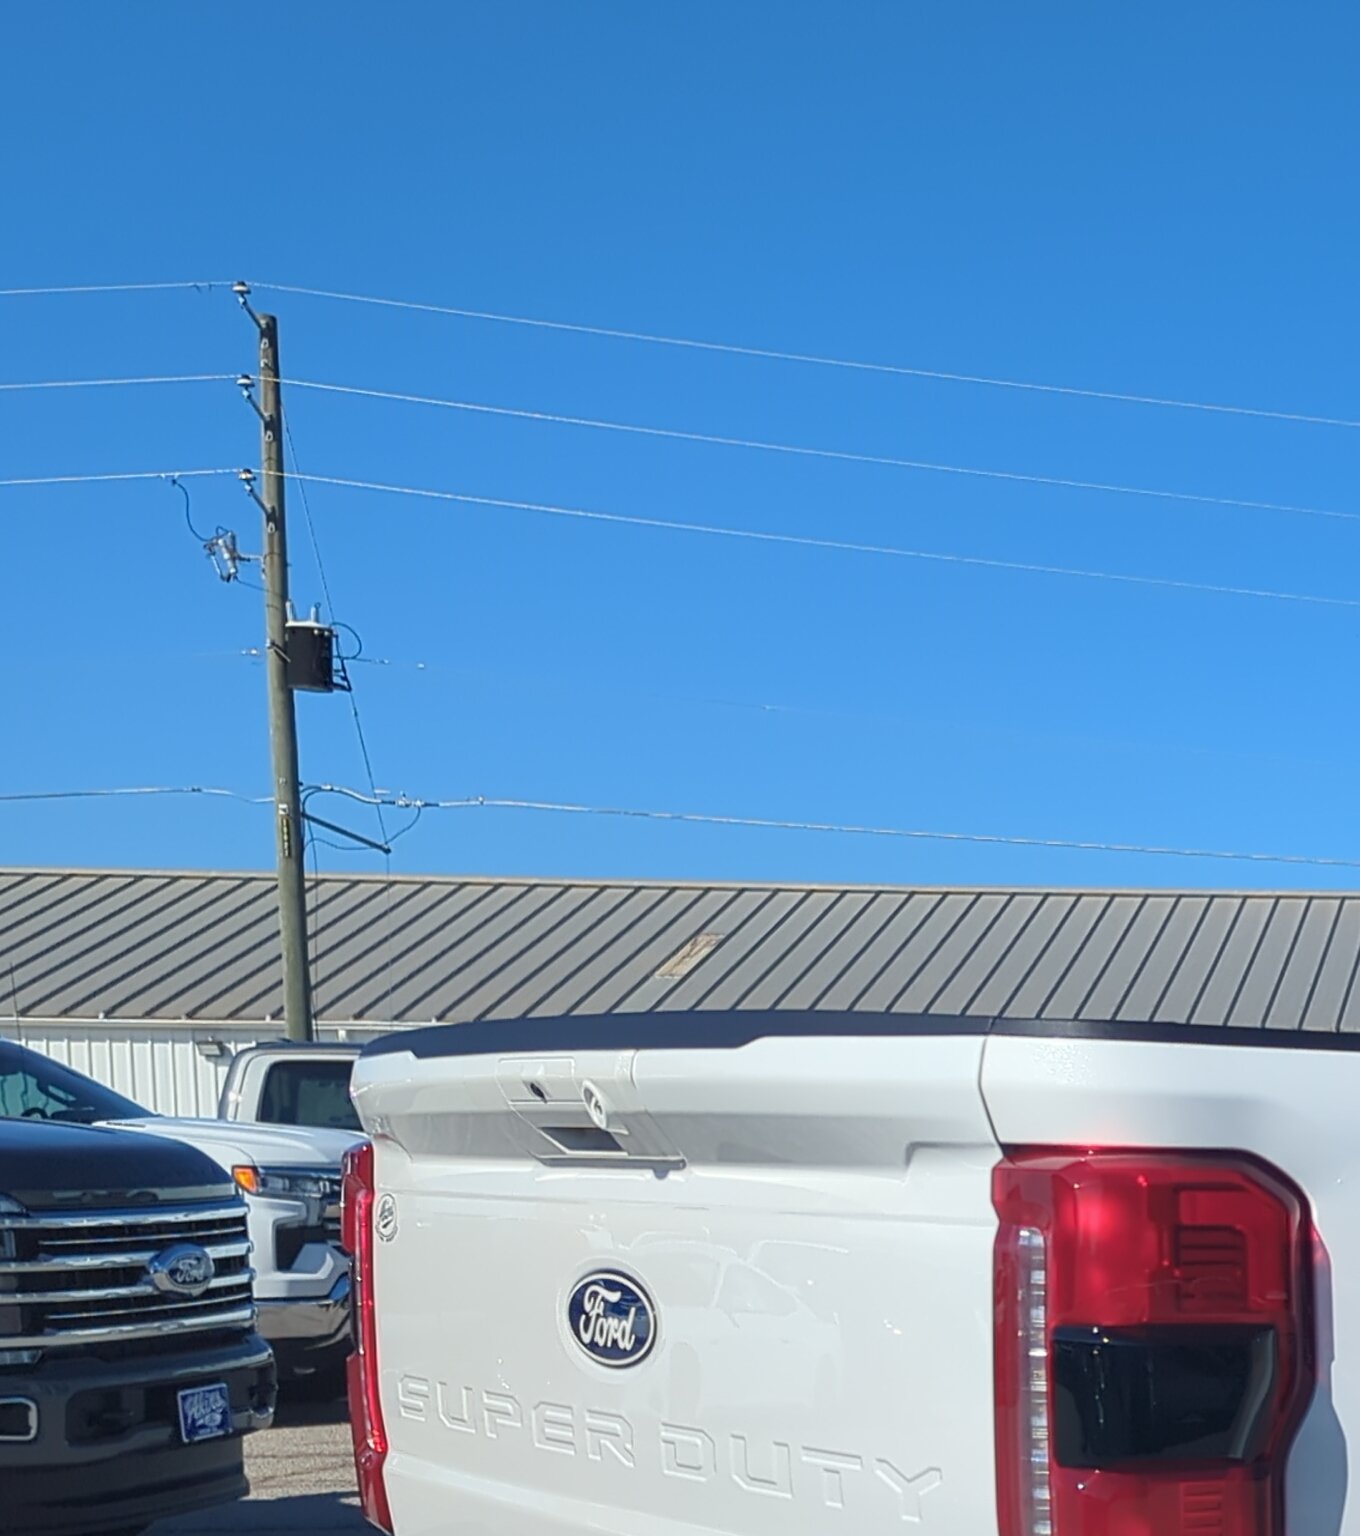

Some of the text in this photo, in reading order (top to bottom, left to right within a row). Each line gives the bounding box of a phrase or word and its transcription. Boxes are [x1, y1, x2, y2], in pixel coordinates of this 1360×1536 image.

[579, 1284, 636, 1351] Ford
[397, 1373, 943, 1523] SUPER DUTY
